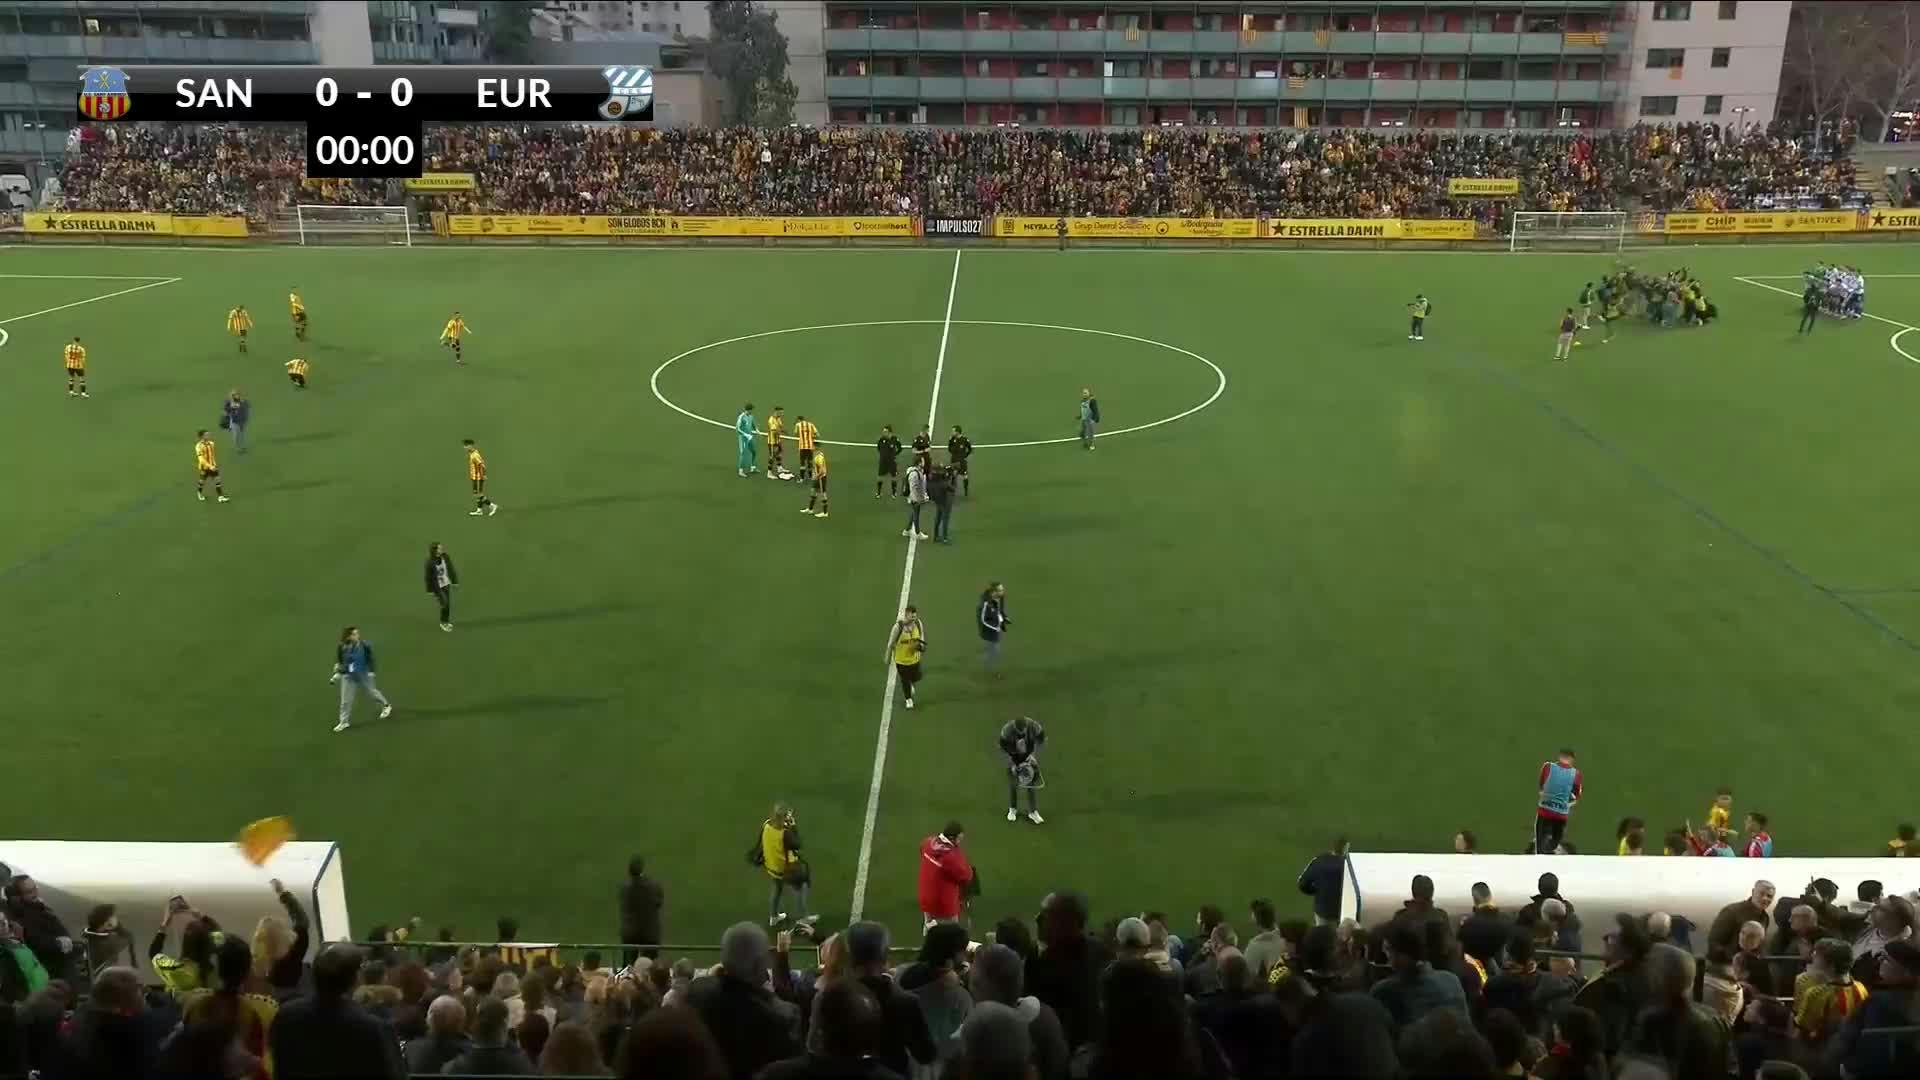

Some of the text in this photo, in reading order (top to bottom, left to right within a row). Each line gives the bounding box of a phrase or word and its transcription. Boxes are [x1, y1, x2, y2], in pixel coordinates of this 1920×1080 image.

[61, 219, 156, 231] ESTRELLA DAMM
[608, 217, 622, 229] SON
[623, 217, 650, 229] GLOBOS
[936, 219, 982, 233] IMPULSO27
[1888, 215, 1920, 226] ESTR
[1288, 225, 1384, 236] ESTRELLA DAMM
